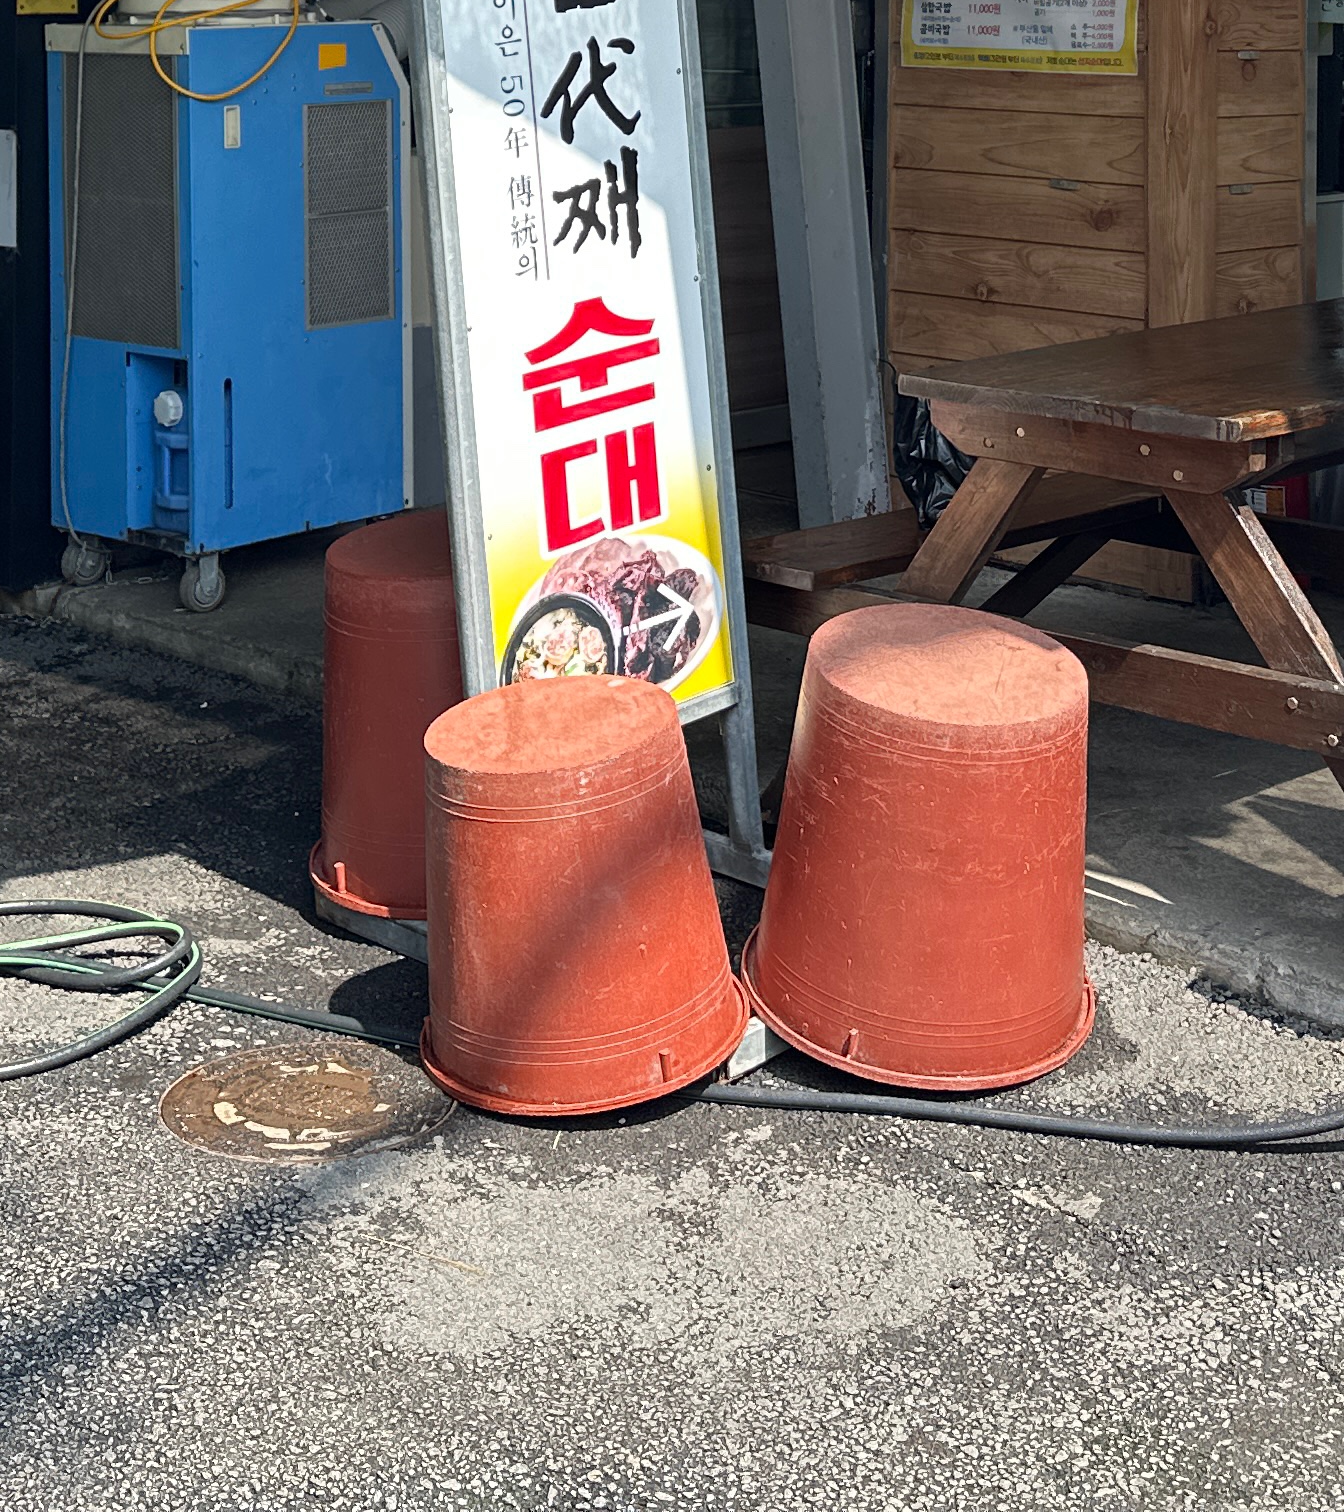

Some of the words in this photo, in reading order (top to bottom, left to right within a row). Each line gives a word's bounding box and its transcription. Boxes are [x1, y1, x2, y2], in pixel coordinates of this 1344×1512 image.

[968, 3, 1002, 15] 11,000원
[1092, 0, 1117, 8] 2,000원
[1092, 8, 1116, 18] 1,000원
[967, 24, 1001, 37] 11,000원
[522, 296, 661, 553] 순대
